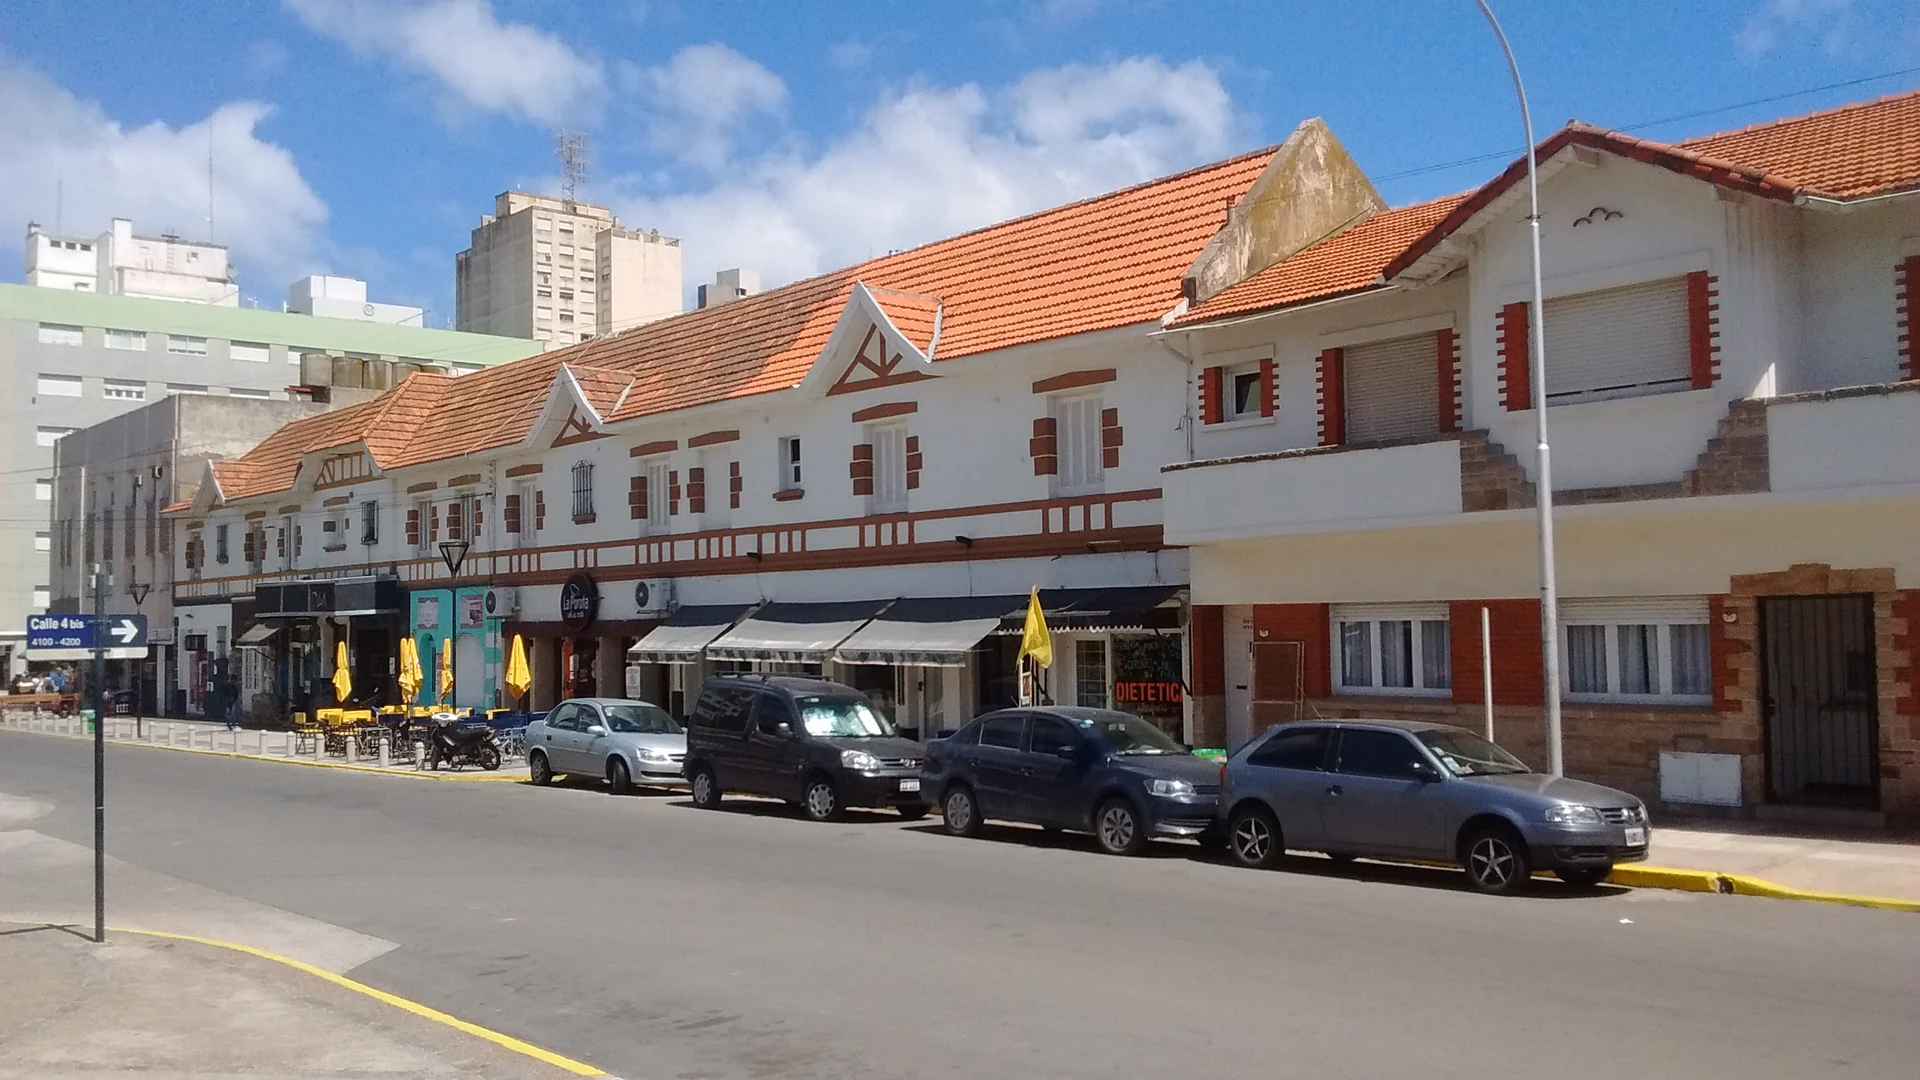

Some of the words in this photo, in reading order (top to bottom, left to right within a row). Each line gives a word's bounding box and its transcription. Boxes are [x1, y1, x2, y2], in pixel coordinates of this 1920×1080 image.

[563, 595, 570, 610] La
[31, 617, 59, 630] Calle
[61, 617, 68, 629] 4
[70, 619, 85, 629] bis
[31, 638, 53, 646] 4100
[60, 638, 81, 646] 4200
